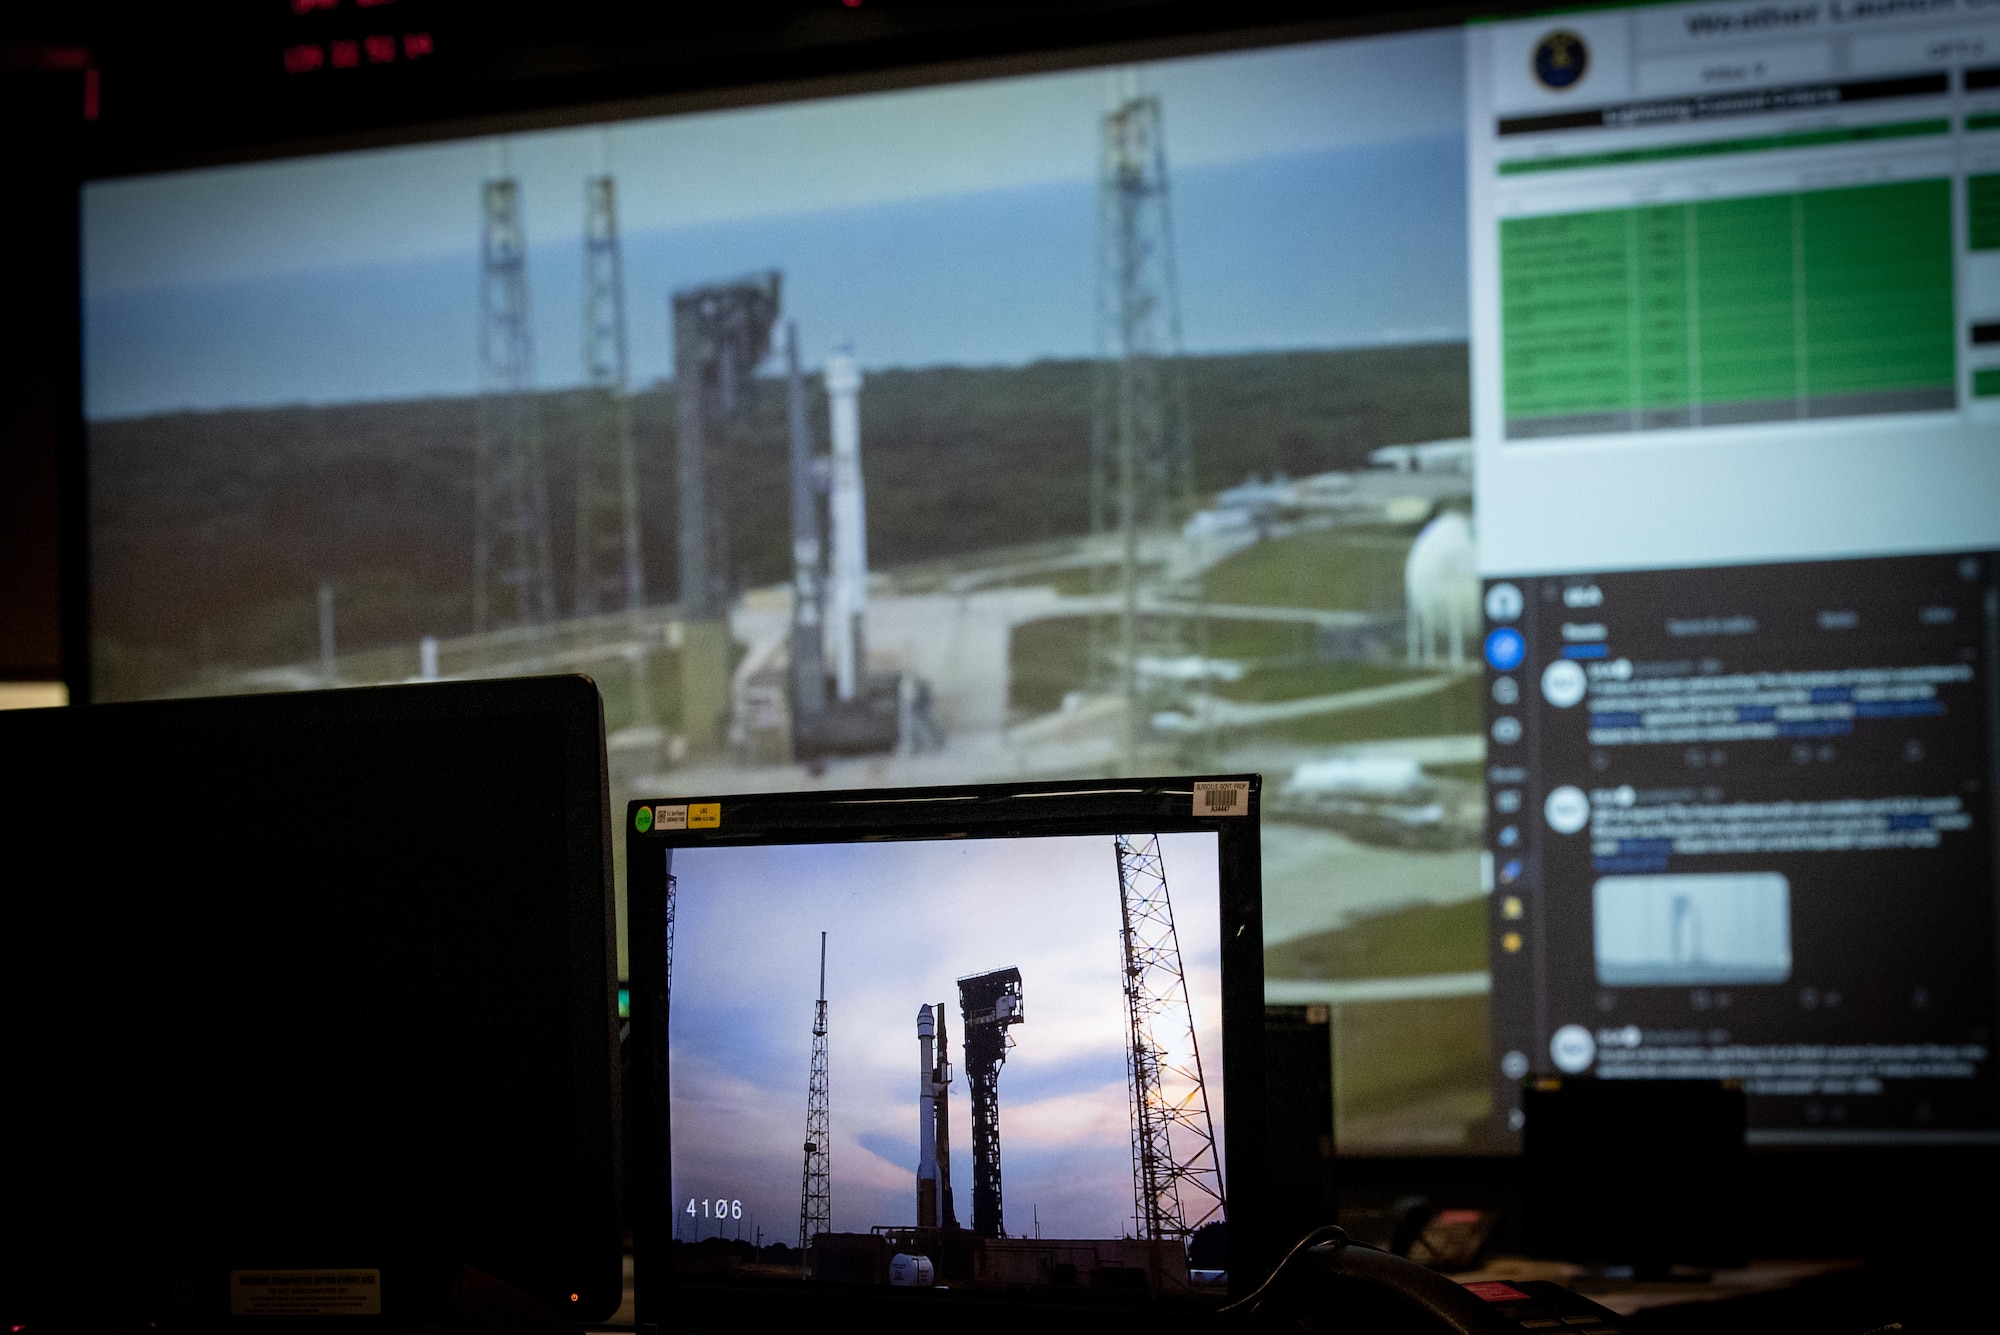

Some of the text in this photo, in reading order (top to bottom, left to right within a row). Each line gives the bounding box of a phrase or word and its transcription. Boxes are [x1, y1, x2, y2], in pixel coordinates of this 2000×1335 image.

[272, 1275, 312, 1285] COMPUTER
[313, 1275, 336, 1284] AFTER
[337, 1275, 360, 1284] EVERY
[362, 1275, 376, 1284] USE
